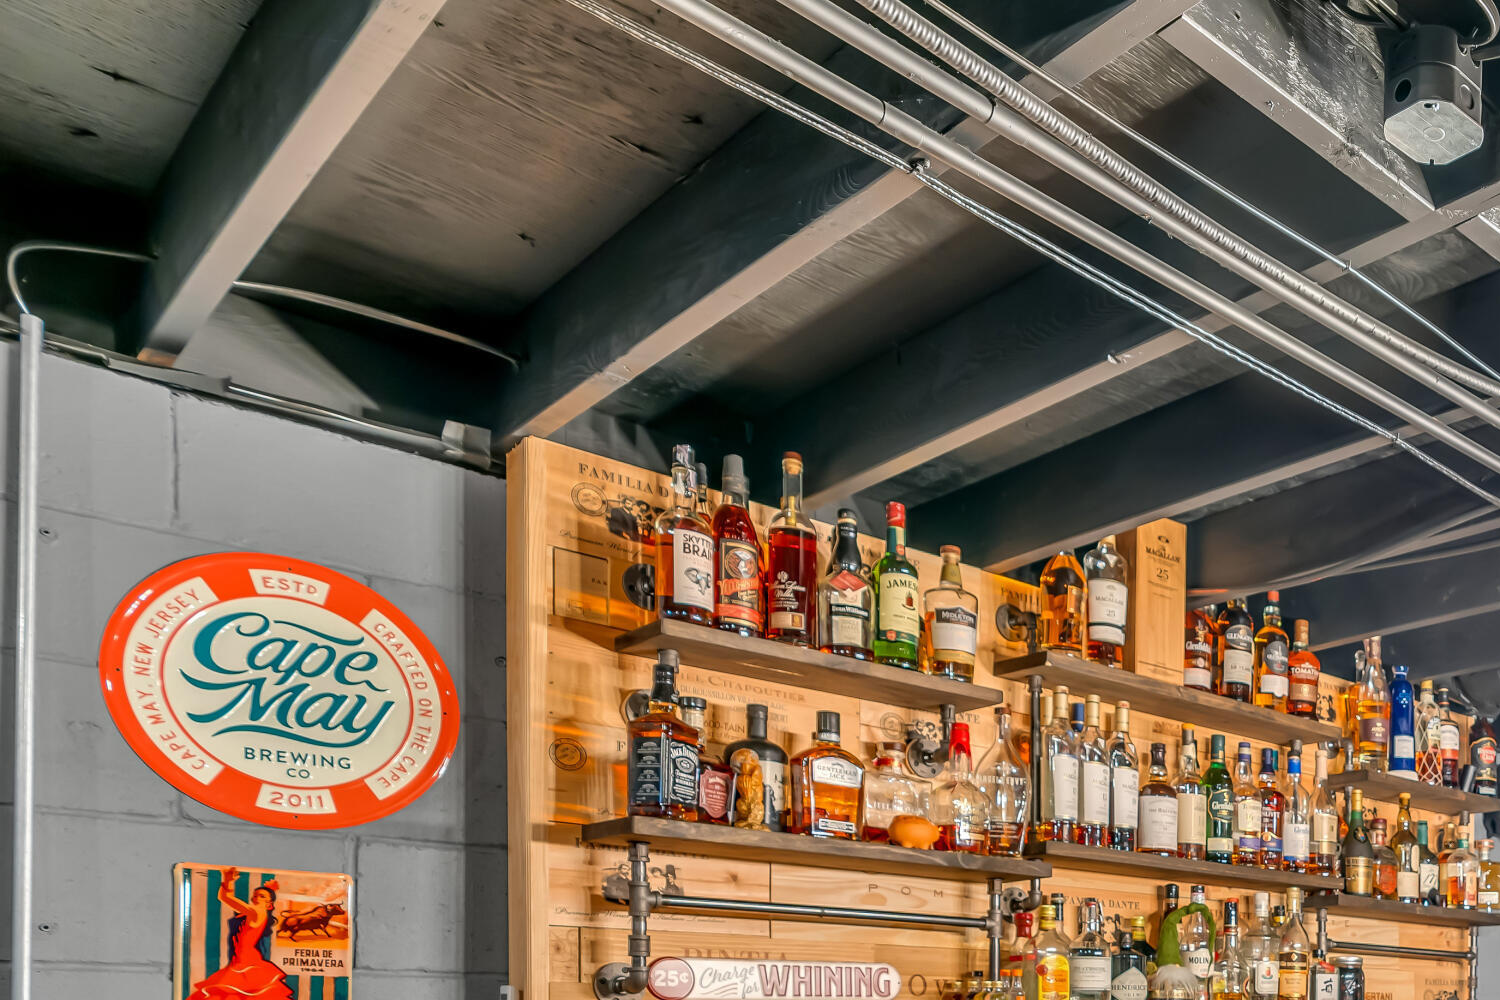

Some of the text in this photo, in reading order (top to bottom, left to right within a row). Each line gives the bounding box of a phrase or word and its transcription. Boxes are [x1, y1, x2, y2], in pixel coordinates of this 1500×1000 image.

[262, 576, 318, 596] ESTD
[1156, 567, 1169, 580] 25
[144, 588, 200, 638] JERSEY
[133, 641, 156, 678] NEW
[192, 611, 391, 692] Cape
[178, 668, 396, 748] May
[373, 622, 433, 790] CRAFTED ON THE CAPE
[161, 729, 211, 772] CAPE
[243, 747, 352, 770] BREWING
[286, 767, 311, 780] CO
[269, 792, 325, 810] 2011
[282, 957, 344, 968] PRIMAVERA
[294, 949, 333, 959] FERIA DE
[700, 965, 755, 989] Charge
[742, 981, 761, 999] for
[758, 964, 892, 998] WHINING
